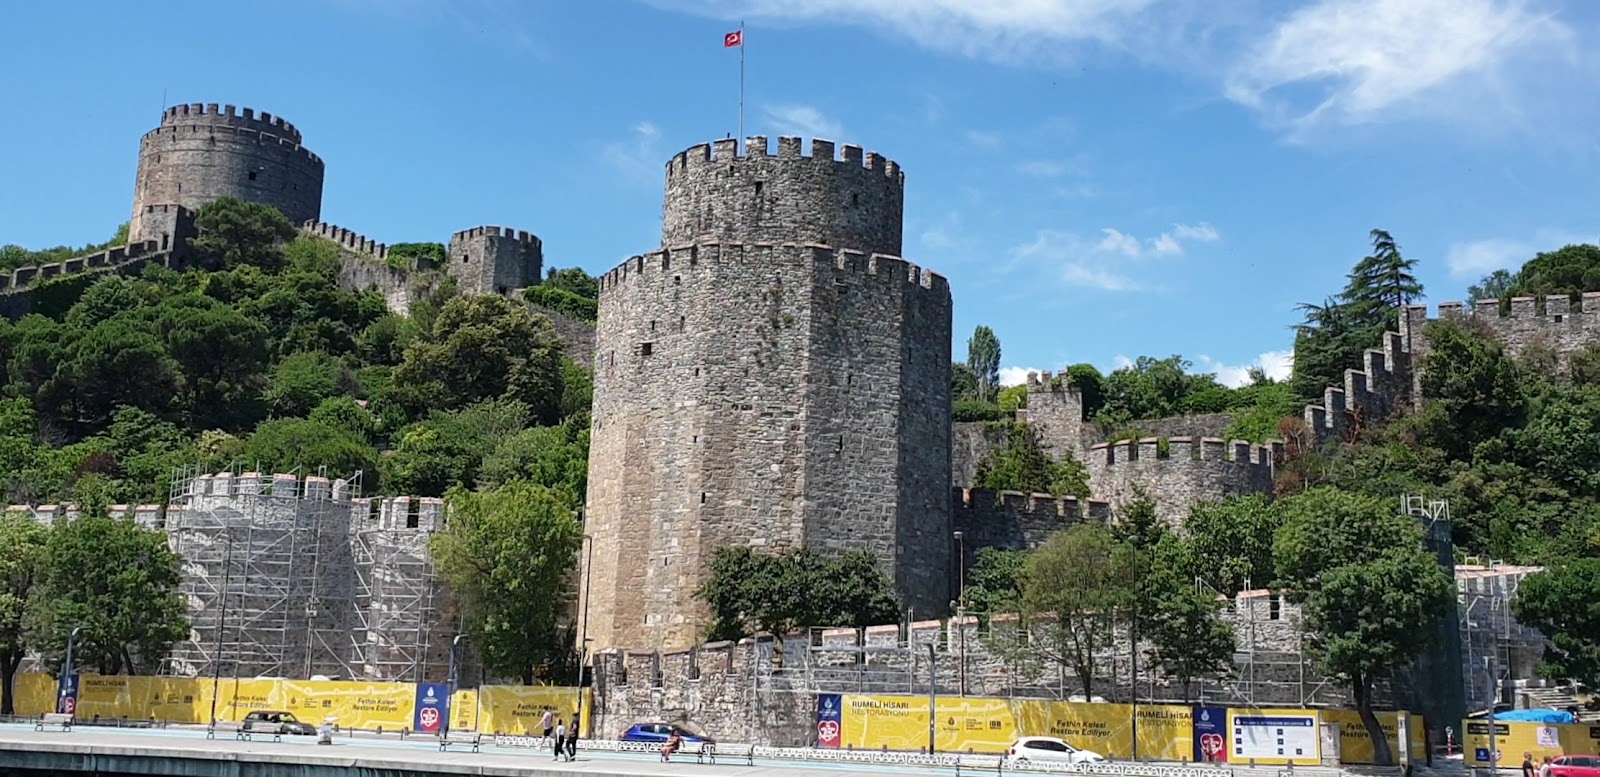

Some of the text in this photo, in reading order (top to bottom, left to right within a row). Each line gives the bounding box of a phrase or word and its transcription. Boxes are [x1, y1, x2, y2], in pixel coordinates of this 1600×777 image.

[852, 700, 909, 708] RUMELİ HİSARI
[1137, 710, 1168, 718] RUMELİ
